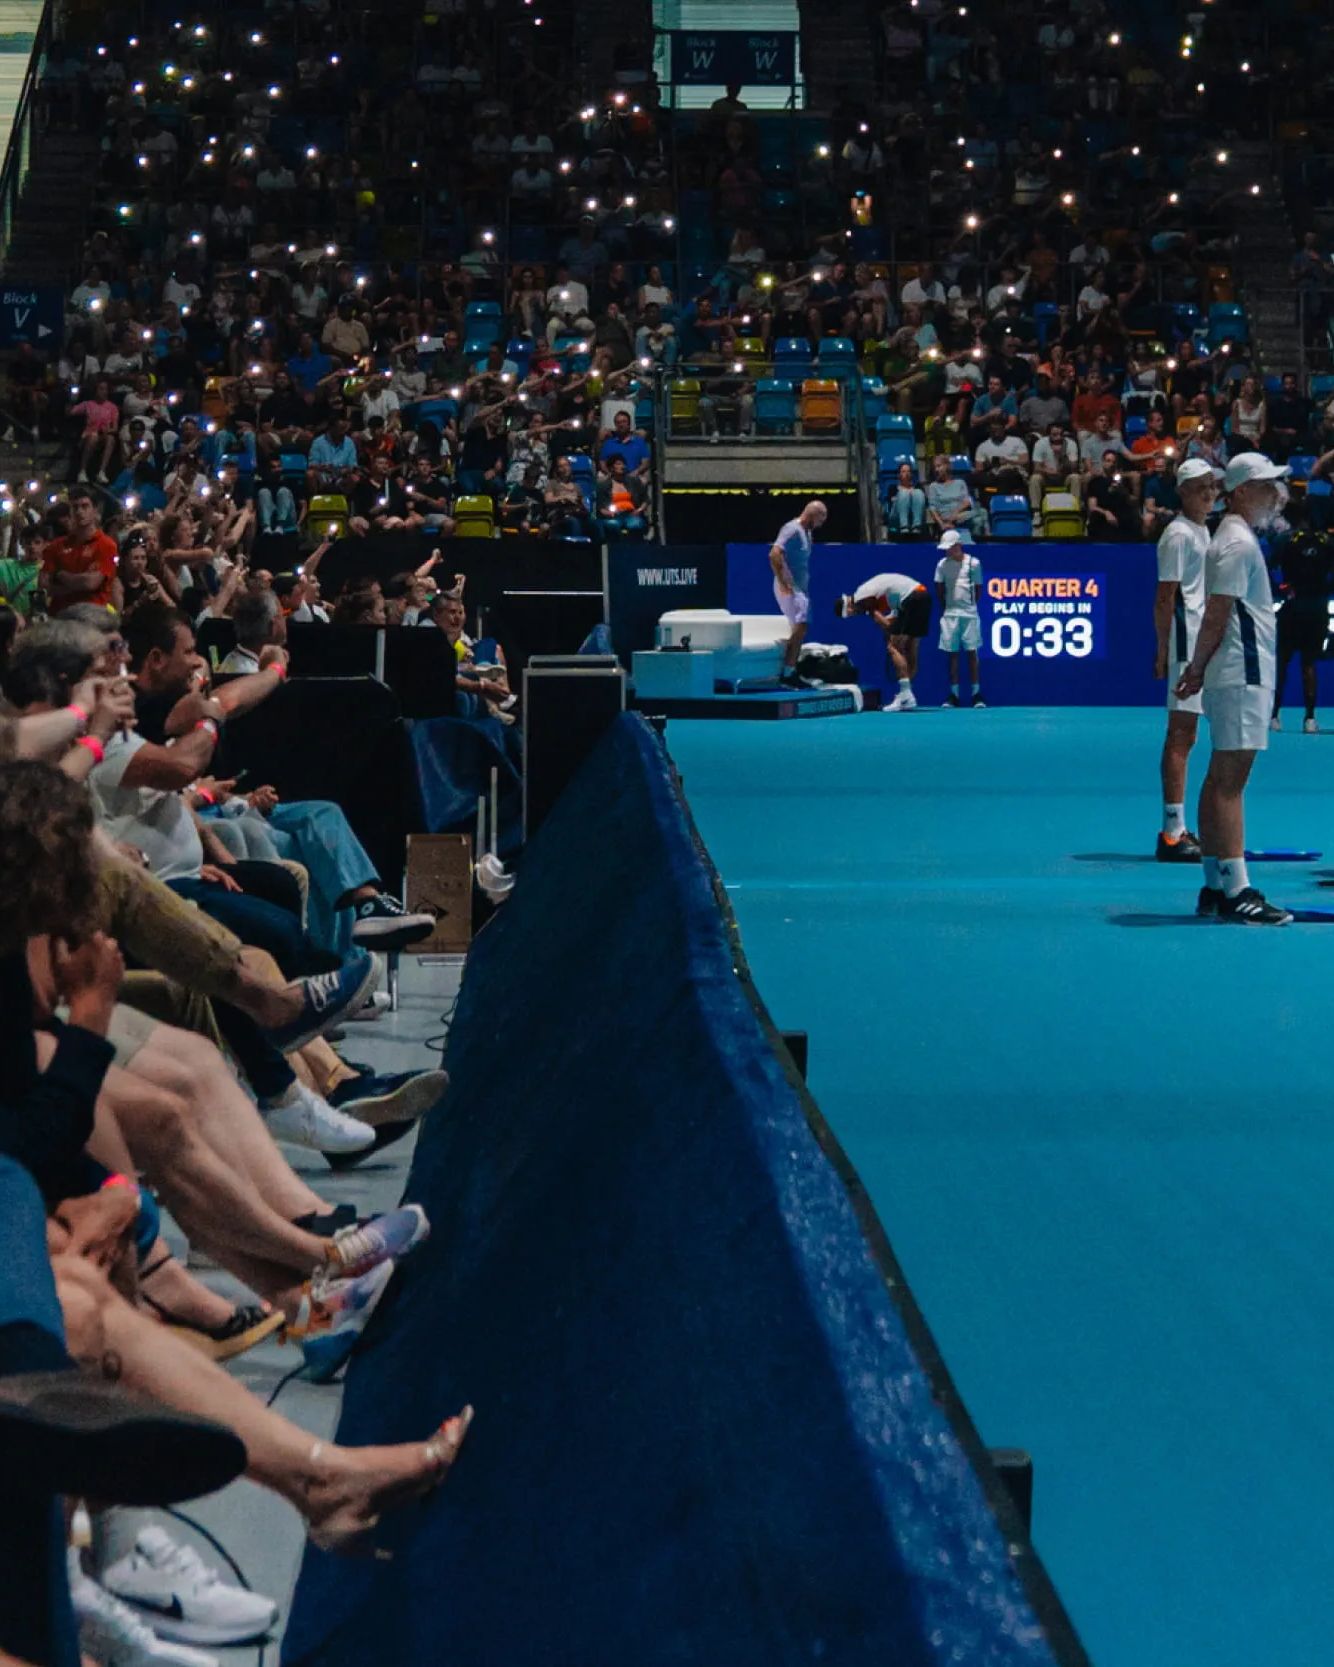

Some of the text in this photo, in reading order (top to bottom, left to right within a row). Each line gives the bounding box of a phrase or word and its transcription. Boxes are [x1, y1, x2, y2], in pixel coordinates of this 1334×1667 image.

[692, 50, 714, 69] W
[754, 51, 778, 70] W
[3, 292, 37, 306] Block
[14, 307, 31, 329] V
[988, 578, 1099, 600] QUARTER 4
[993, 602, 1091, 614] PLAY BEGINS IN
[991, 617, 1094, 657] 0:33
